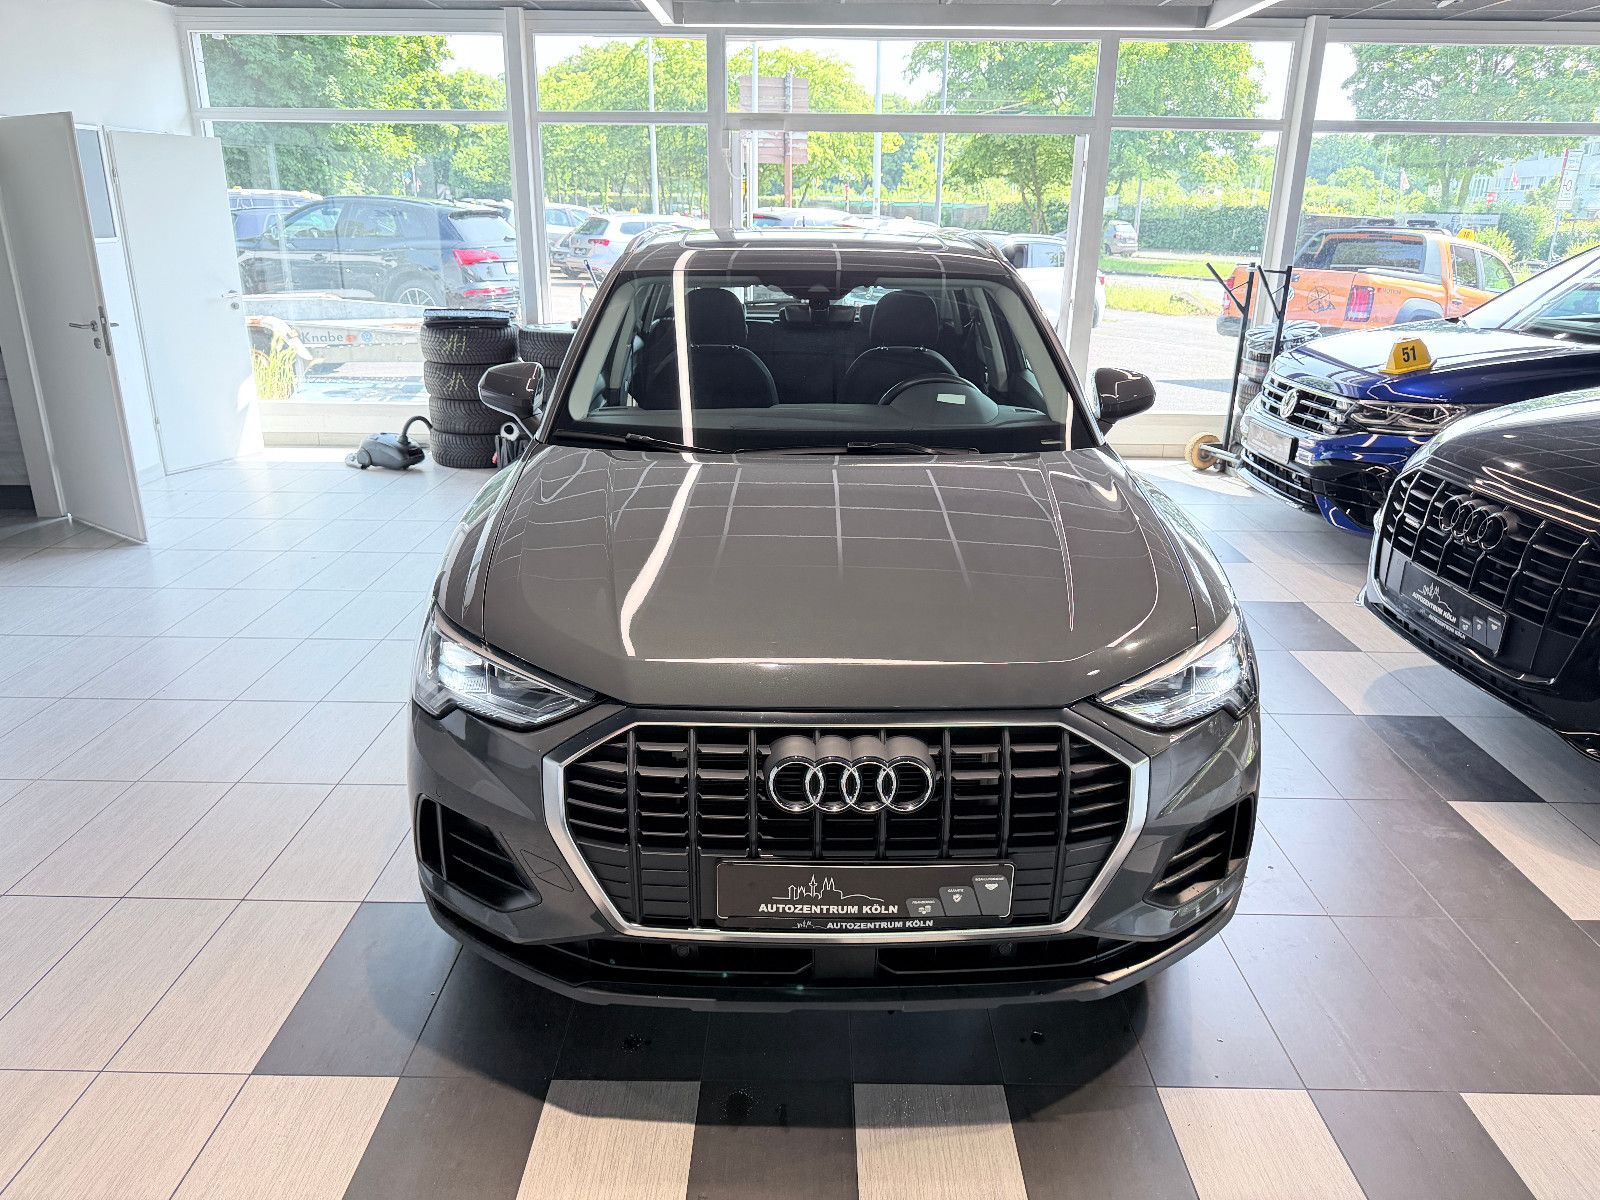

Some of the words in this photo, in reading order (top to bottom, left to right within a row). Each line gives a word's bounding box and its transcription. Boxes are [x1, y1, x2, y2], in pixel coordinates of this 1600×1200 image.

[301, 331, 343, 342] Knabe
[1402, 345, 1417, 363] 51
[759, 903, 859, 914] AUTOZENTRUM
[862, 903, 899, 914] KÖLN
[827, 921, 903, 930] AUTOZENTRUM
[905, 919, 934, 929] KÖLN
